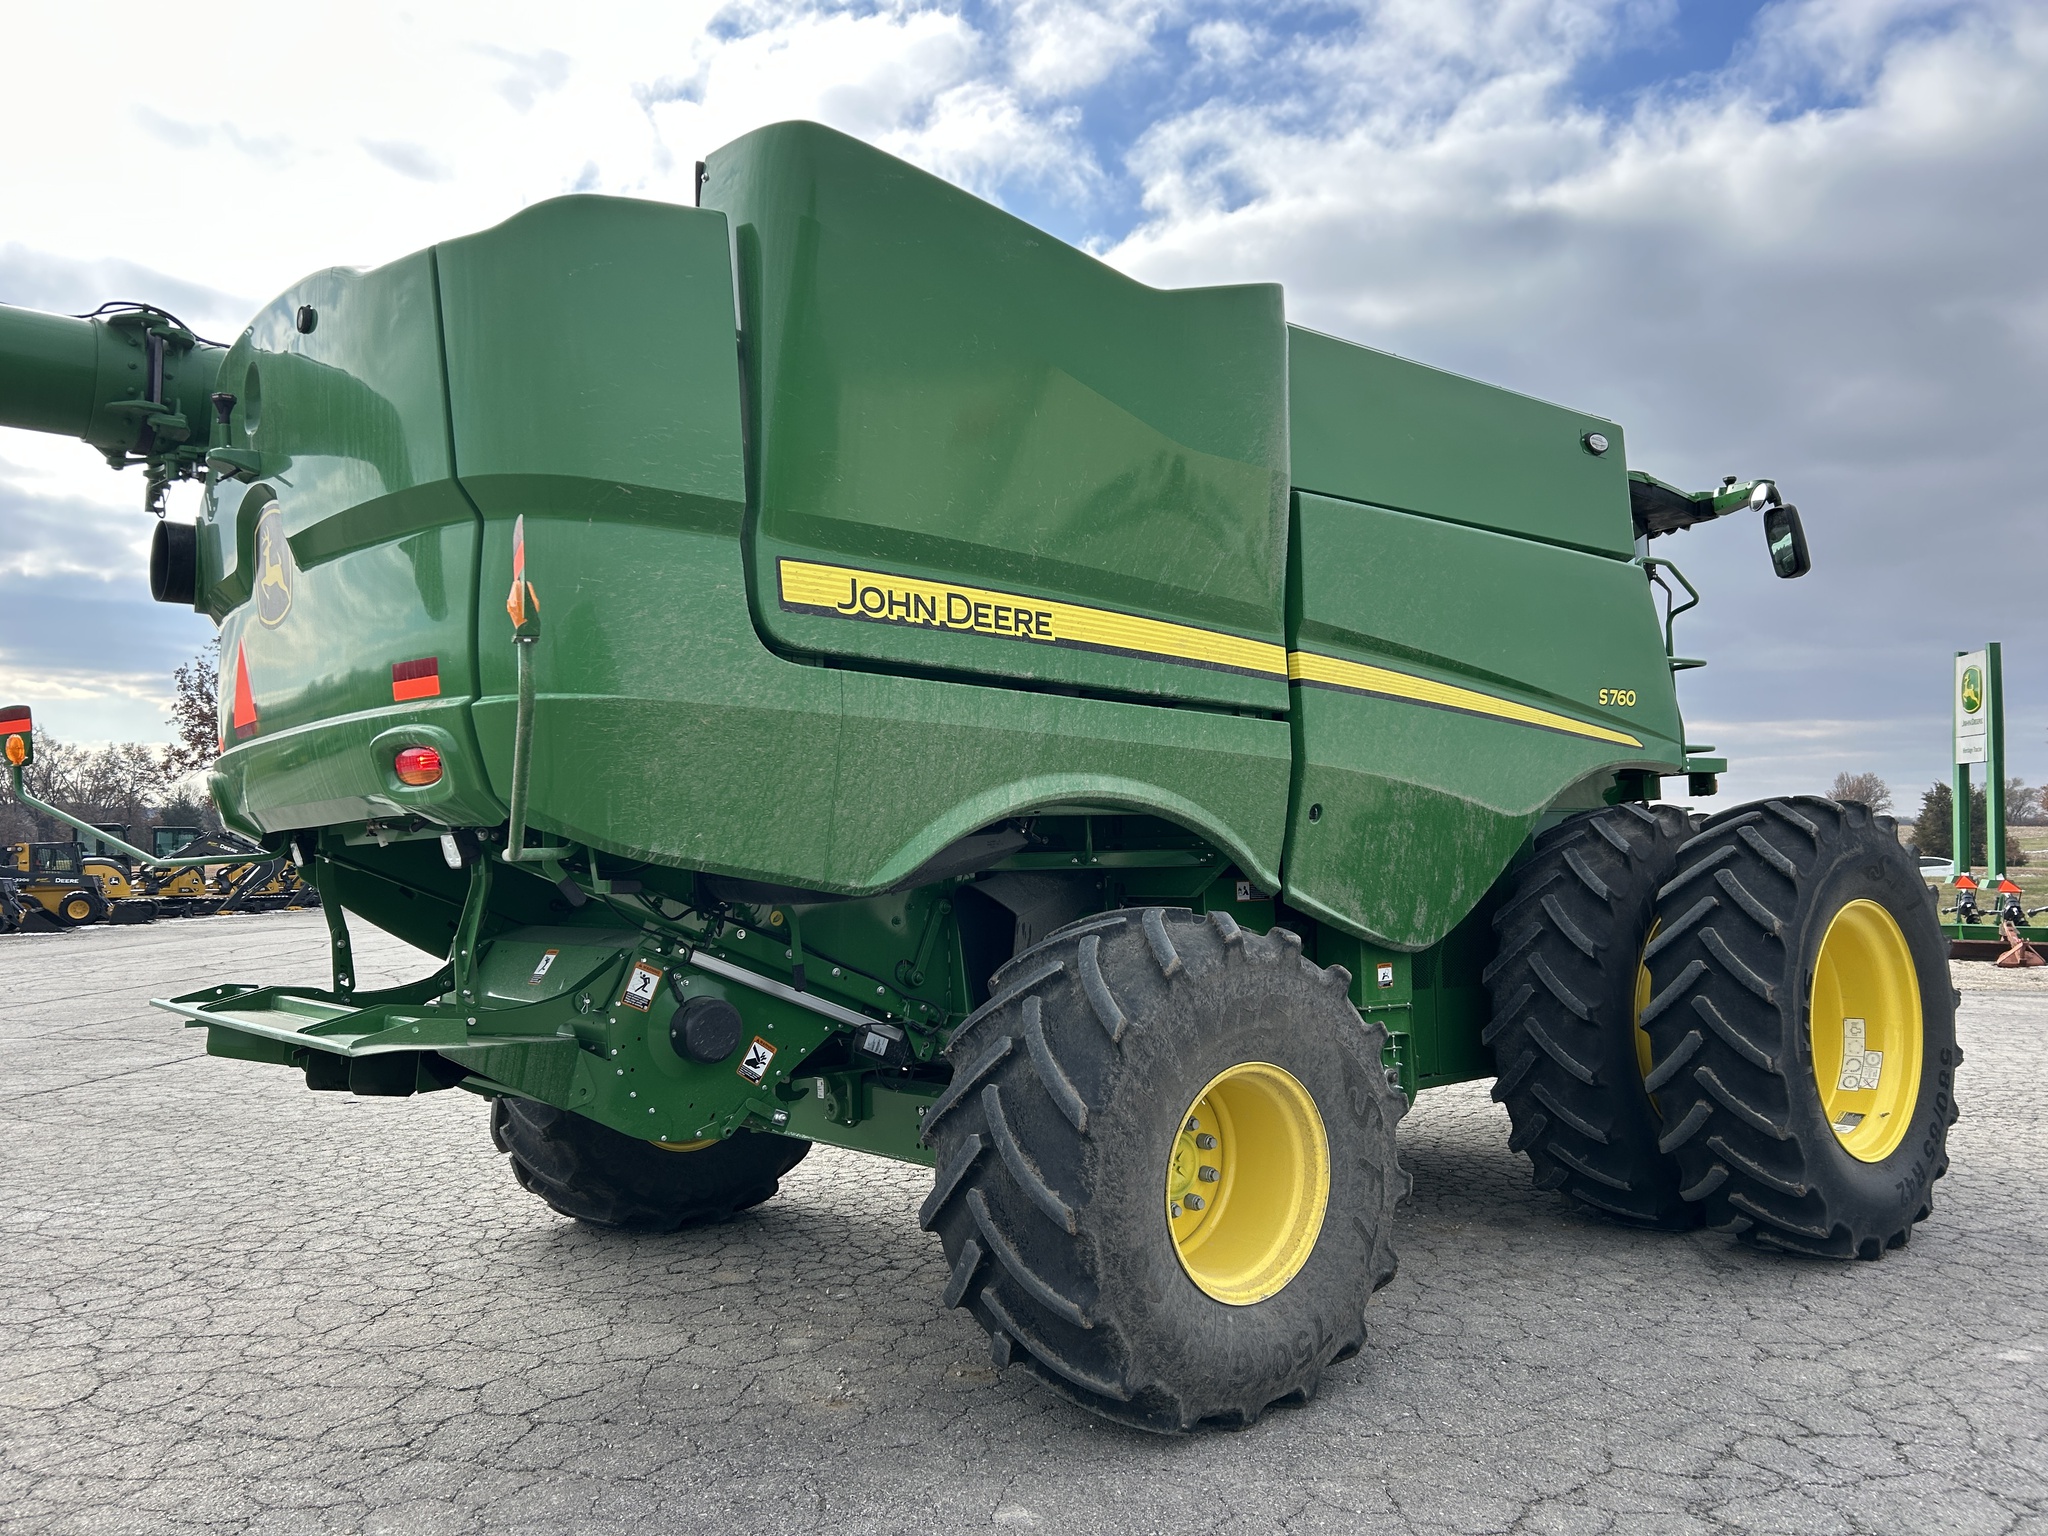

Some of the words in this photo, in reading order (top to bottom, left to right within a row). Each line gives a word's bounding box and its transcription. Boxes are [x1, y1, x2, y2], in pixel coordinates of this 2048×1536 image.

[837, 578, 937, 621] JOHN
[947, 592, 1053, 637] DEERE
[1599, 688, 1637, 707] S760
[219, 843, 239, 854] DEERE
[1923, 1047, 1953, 1164] 580/85
[1895, 1159, 1927, 1208] R42
